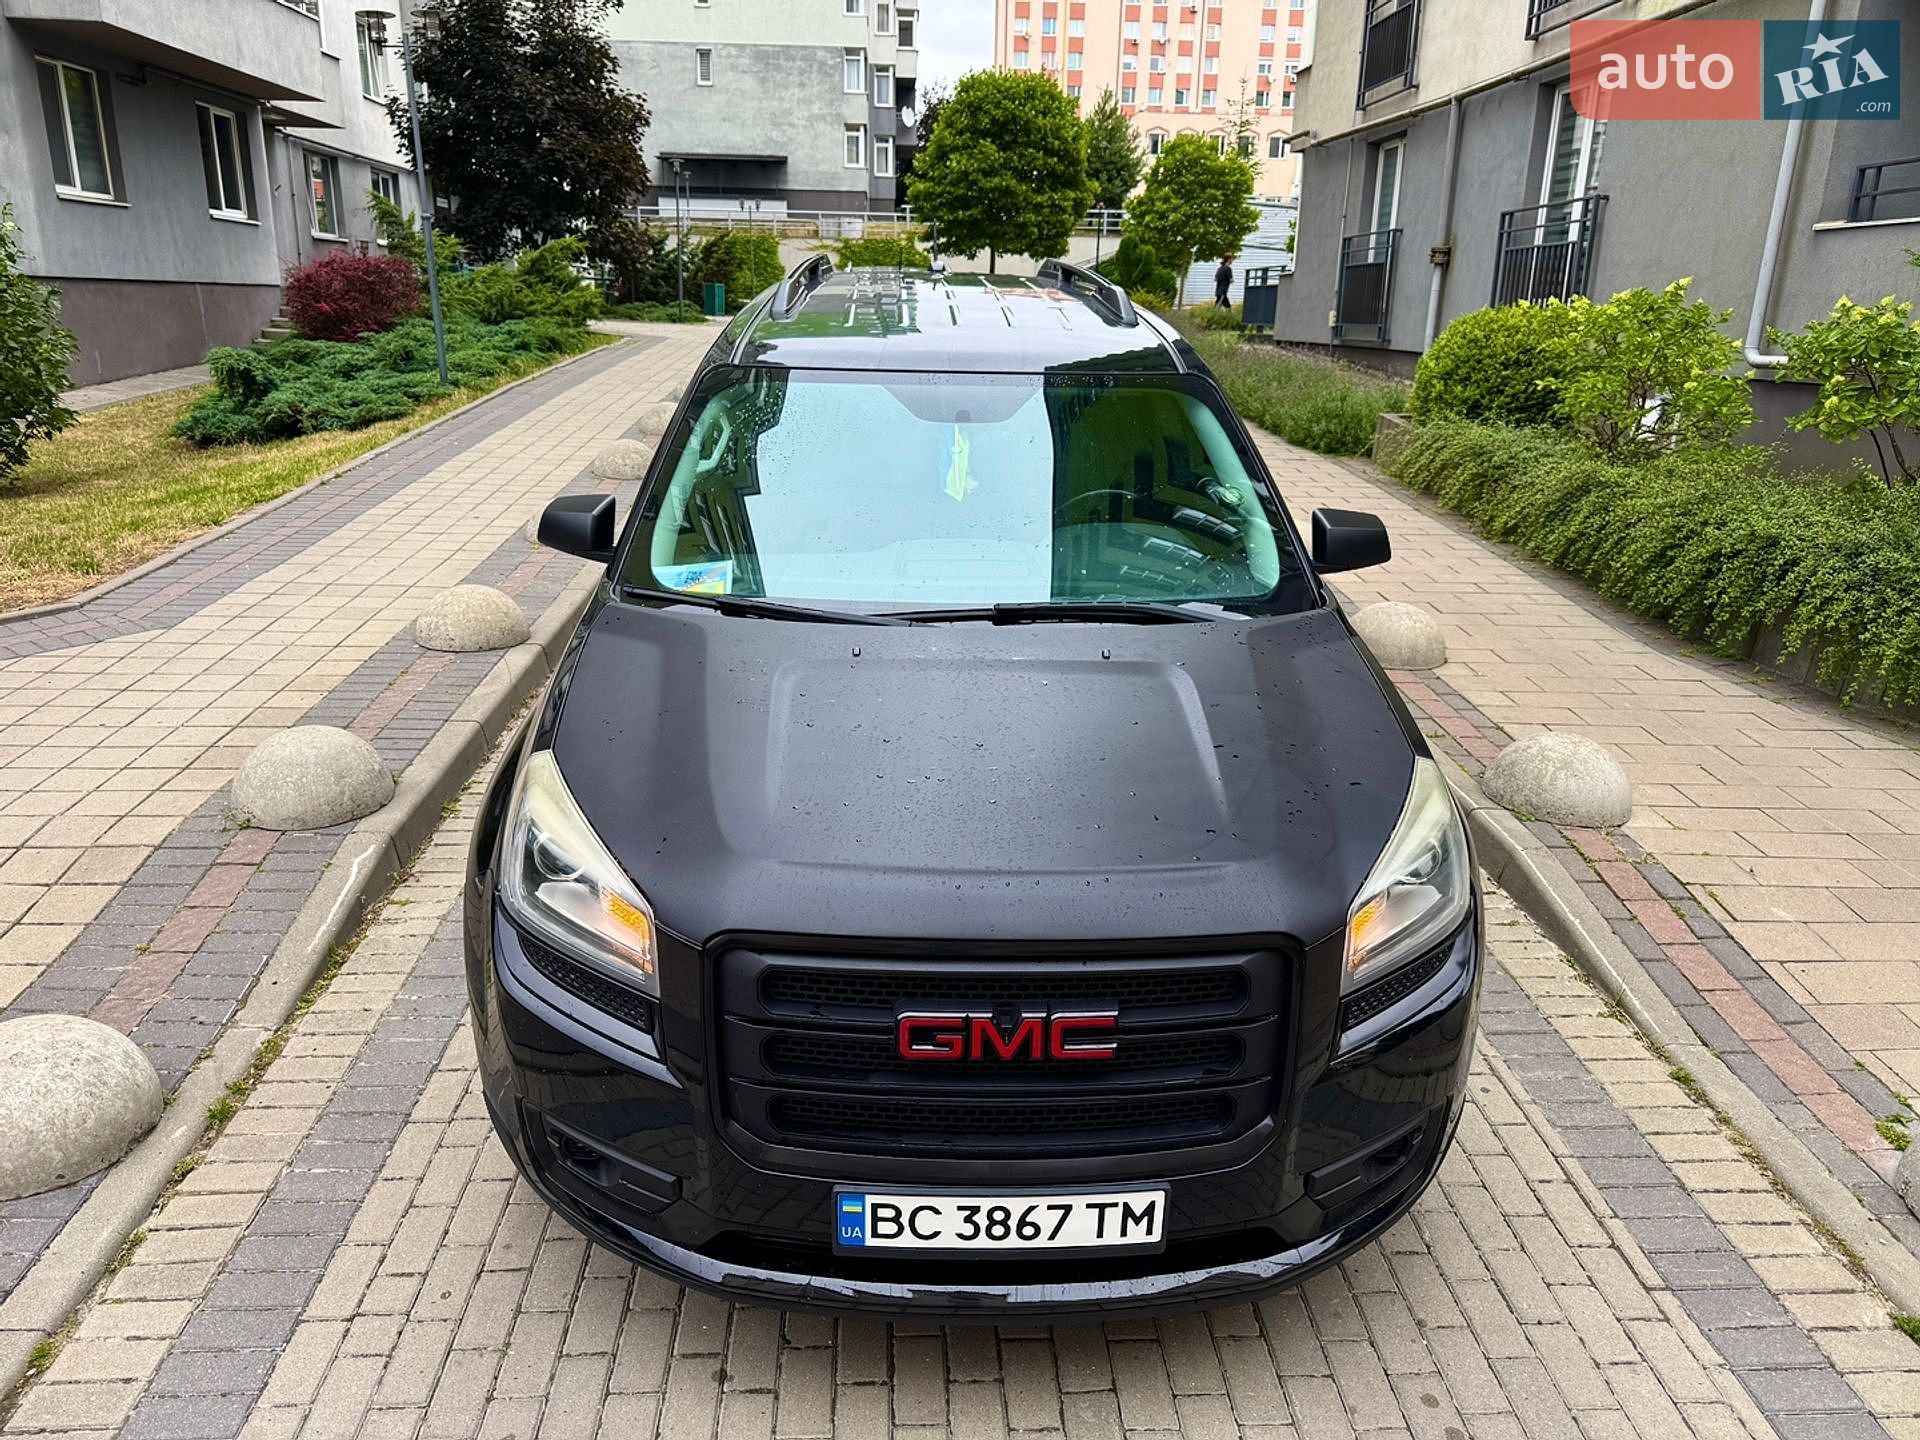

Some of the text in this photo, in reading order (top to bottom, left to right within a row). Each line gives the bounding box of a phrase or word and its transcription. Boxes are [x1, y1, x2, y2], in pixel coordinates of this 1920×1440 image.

[897, 1010, 1119, 1060] GMC
[842, 1227, 862, 1239] UA
[870, 1200, 1156, 1241] BC 3867 TM
